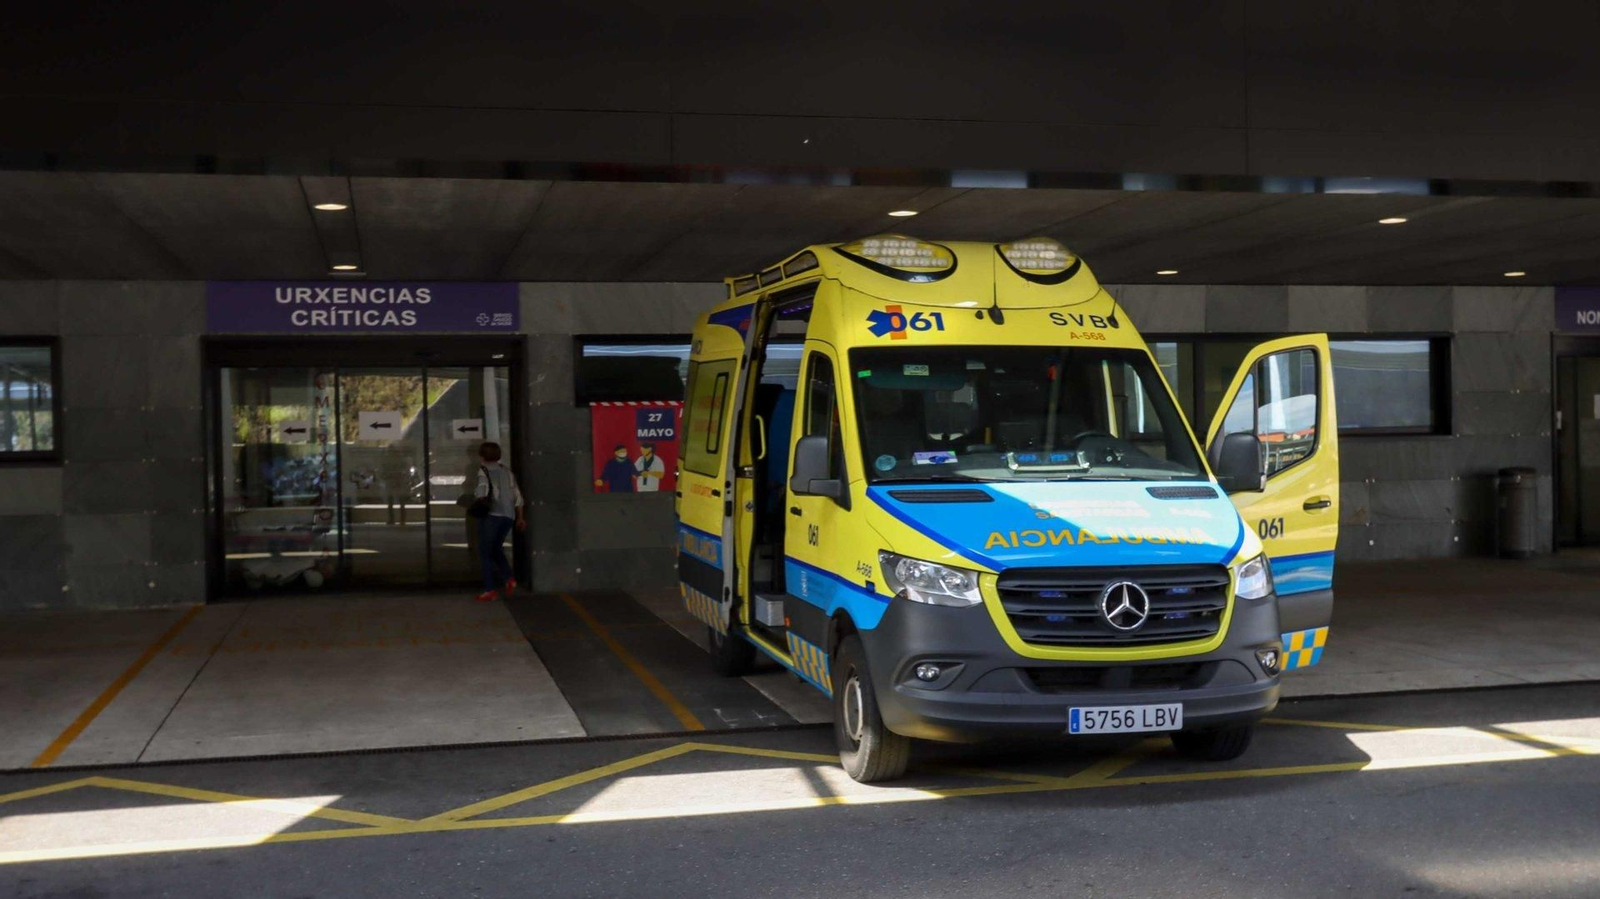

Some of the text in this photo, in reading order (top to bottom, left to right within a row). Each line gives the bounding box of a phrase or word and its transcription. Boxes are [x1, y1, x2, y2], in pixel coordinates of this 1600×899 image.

[275, 287, 432, 304] URXENCIAS
[290, 306, 418, 327] CRÍTICAS
[888, 312, 945, 332] 061
[1070, 331, 1106, 341] A-568
[647, 413, 663, 422] 27
[637, 428, 674, 438] MAYO
[808, 523, 819, 547] 061
[1258, 517, 1285, 540] 061
[1084, 710, 1135, 730] 5756
[1143, 707, 1178, 728] LBV
